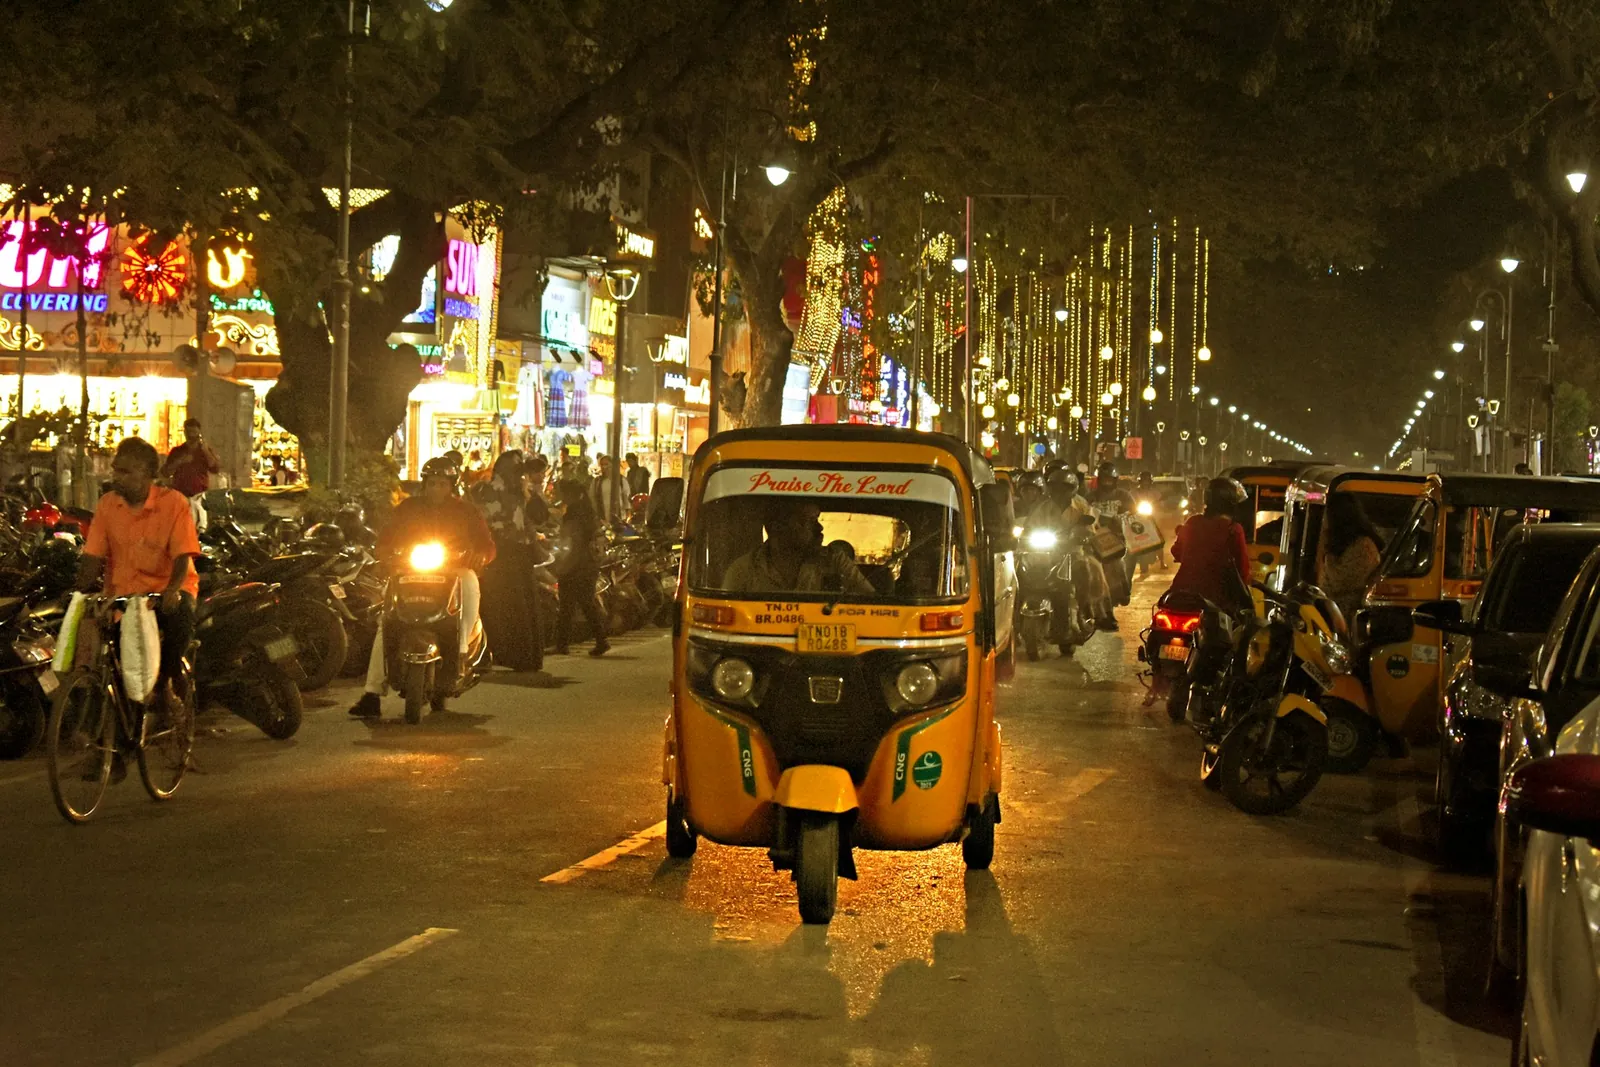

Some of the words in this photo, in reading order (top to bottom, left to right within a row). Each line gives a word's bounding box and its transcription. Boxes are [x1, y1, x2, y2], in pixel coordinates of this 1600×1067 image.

[2, 293, 108, 313] COVERING
[748, 471, 814, 493] Praise
[815, 472, 853, 493] The
[856, 475, 914, 495] Lord
[765, 603, 801, 612] TN.01
[838, 608, 866, 616] FOR
[870, 609, 900, 617] HIRE
[755, 614, 805, 624] BR.0486
[742, 749, 753, 778] CNG
[895, 752, 906, 781] CNG
